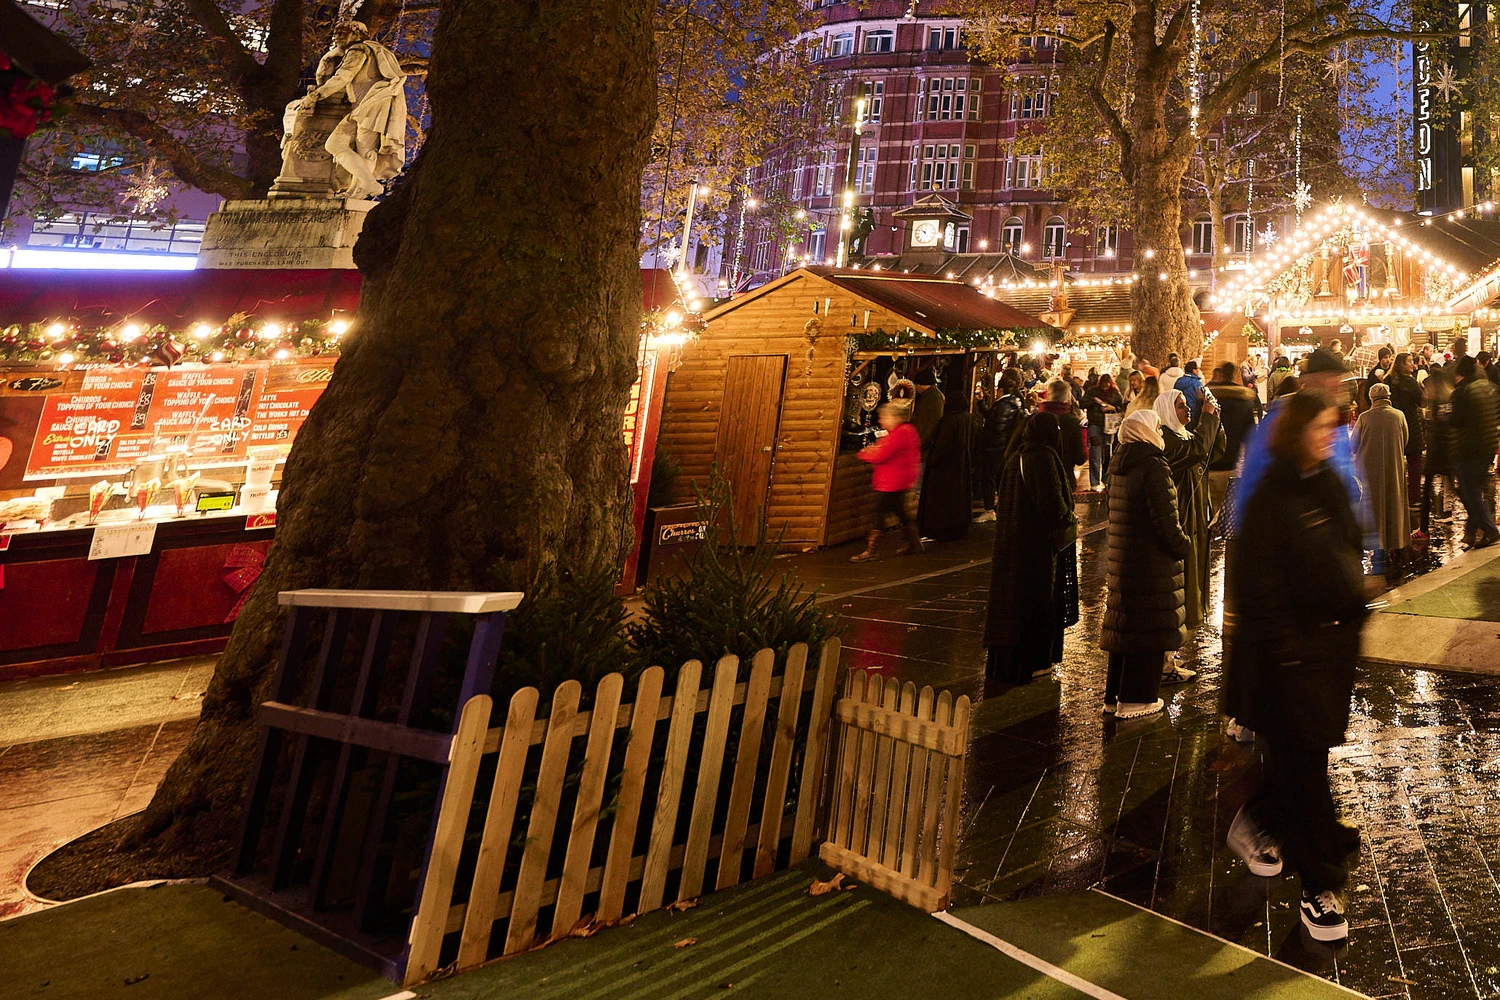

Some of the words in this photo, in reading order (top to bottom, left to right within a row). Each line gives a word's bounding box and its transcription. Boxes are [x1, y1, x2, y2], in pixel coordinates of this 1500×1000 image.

[57, 403, 86, 411] TOPPING
[51, 423, 72, 431] SAUCE
[66, 416, 96, 424] CHURROS
[74, 420, 120, 434] CARD
[210, 416, 252, 430] CARD
[70, 433, 118, 448] ONLY
[211, 430, 250, 445] ONLY
